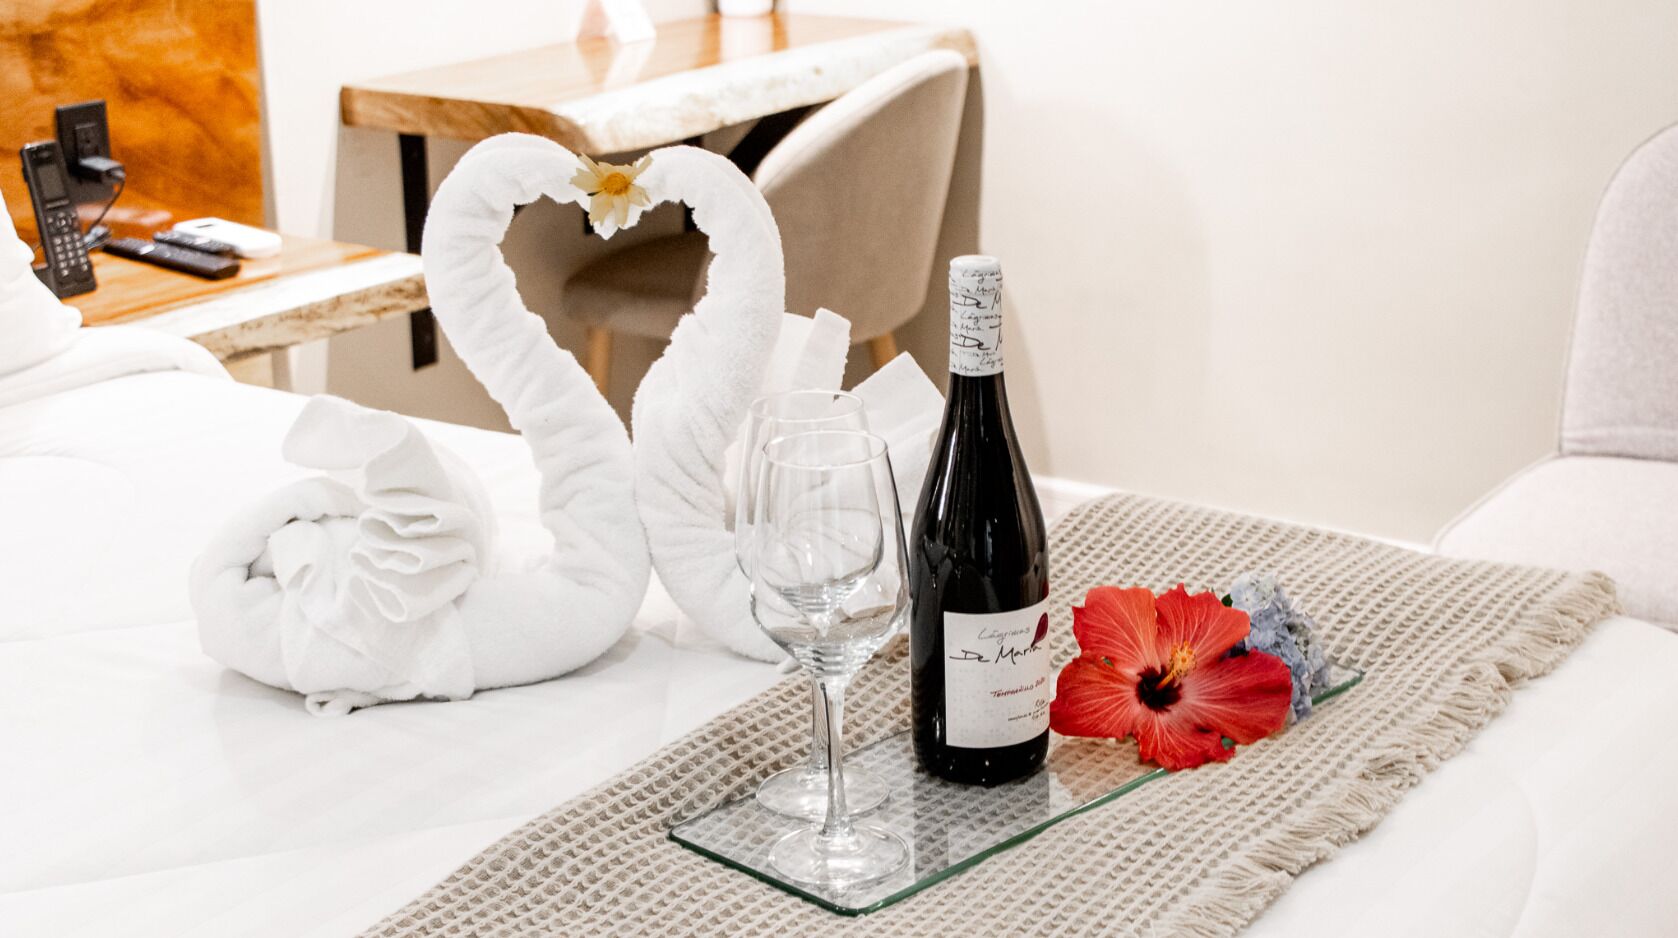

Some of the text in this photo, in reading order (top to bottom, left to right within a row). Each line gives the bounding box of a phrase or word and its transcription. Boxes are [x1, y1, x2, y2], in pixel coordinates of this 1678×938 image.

[951, 294, 988, 309] De
[951, 334, 991, 350] De
[949, 649, 991, 663] De
